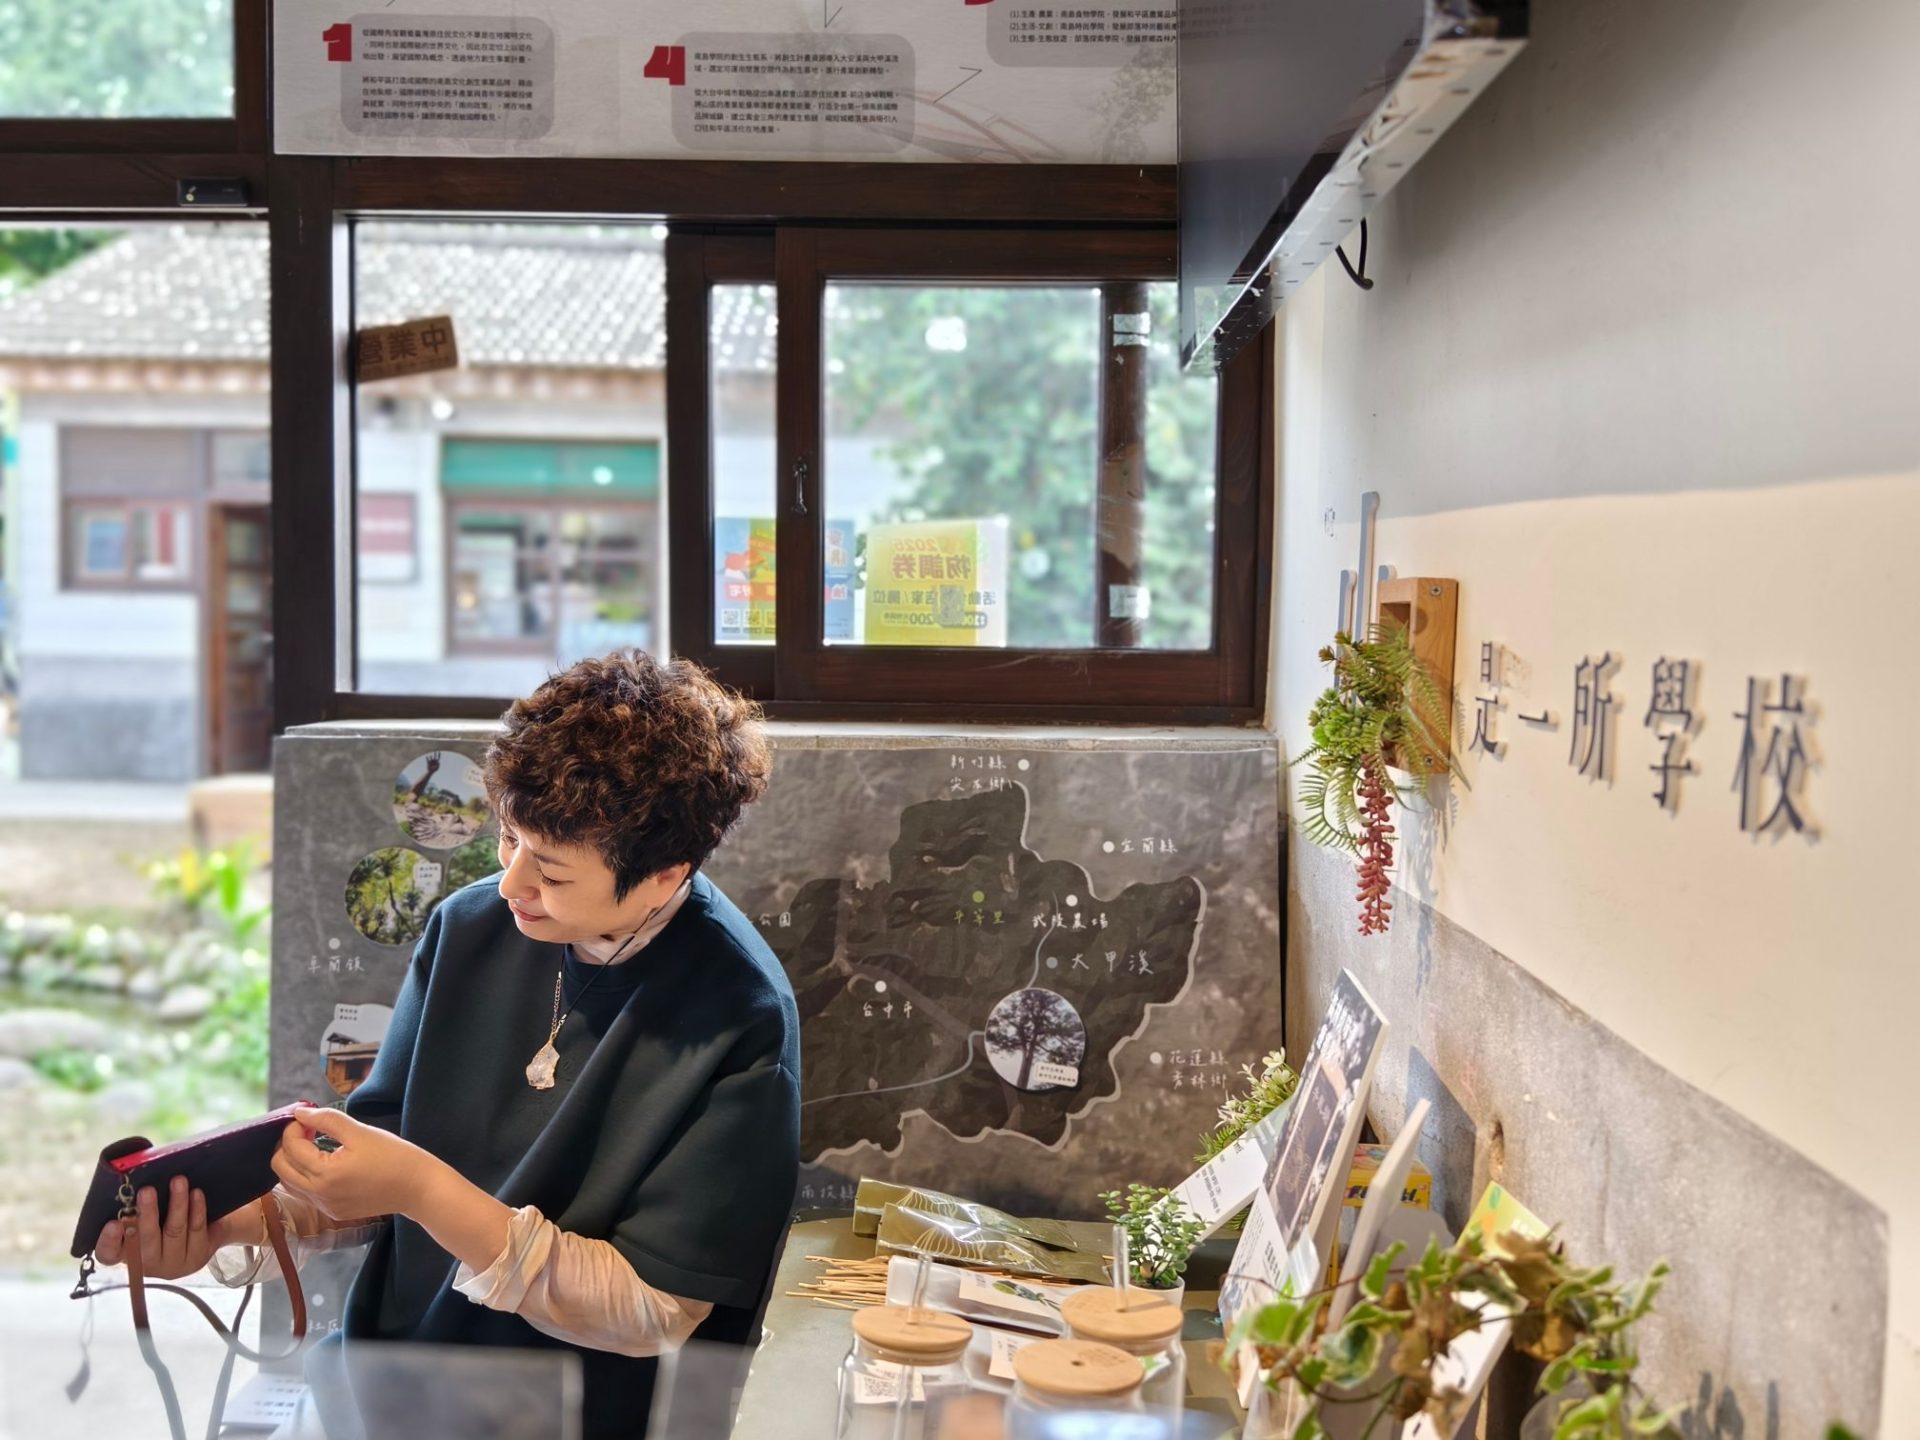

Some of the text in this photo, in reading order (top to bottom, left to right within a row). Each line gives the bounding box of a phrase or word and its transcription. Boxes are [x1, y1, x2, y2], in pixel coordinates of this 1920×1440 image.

[322, 23, 352, 62] 1
[644, 45, 686, 86] 4
[1072, 949, 1154, 975] 大甲溪
[862, 1000, 913, 1019] 台中市
